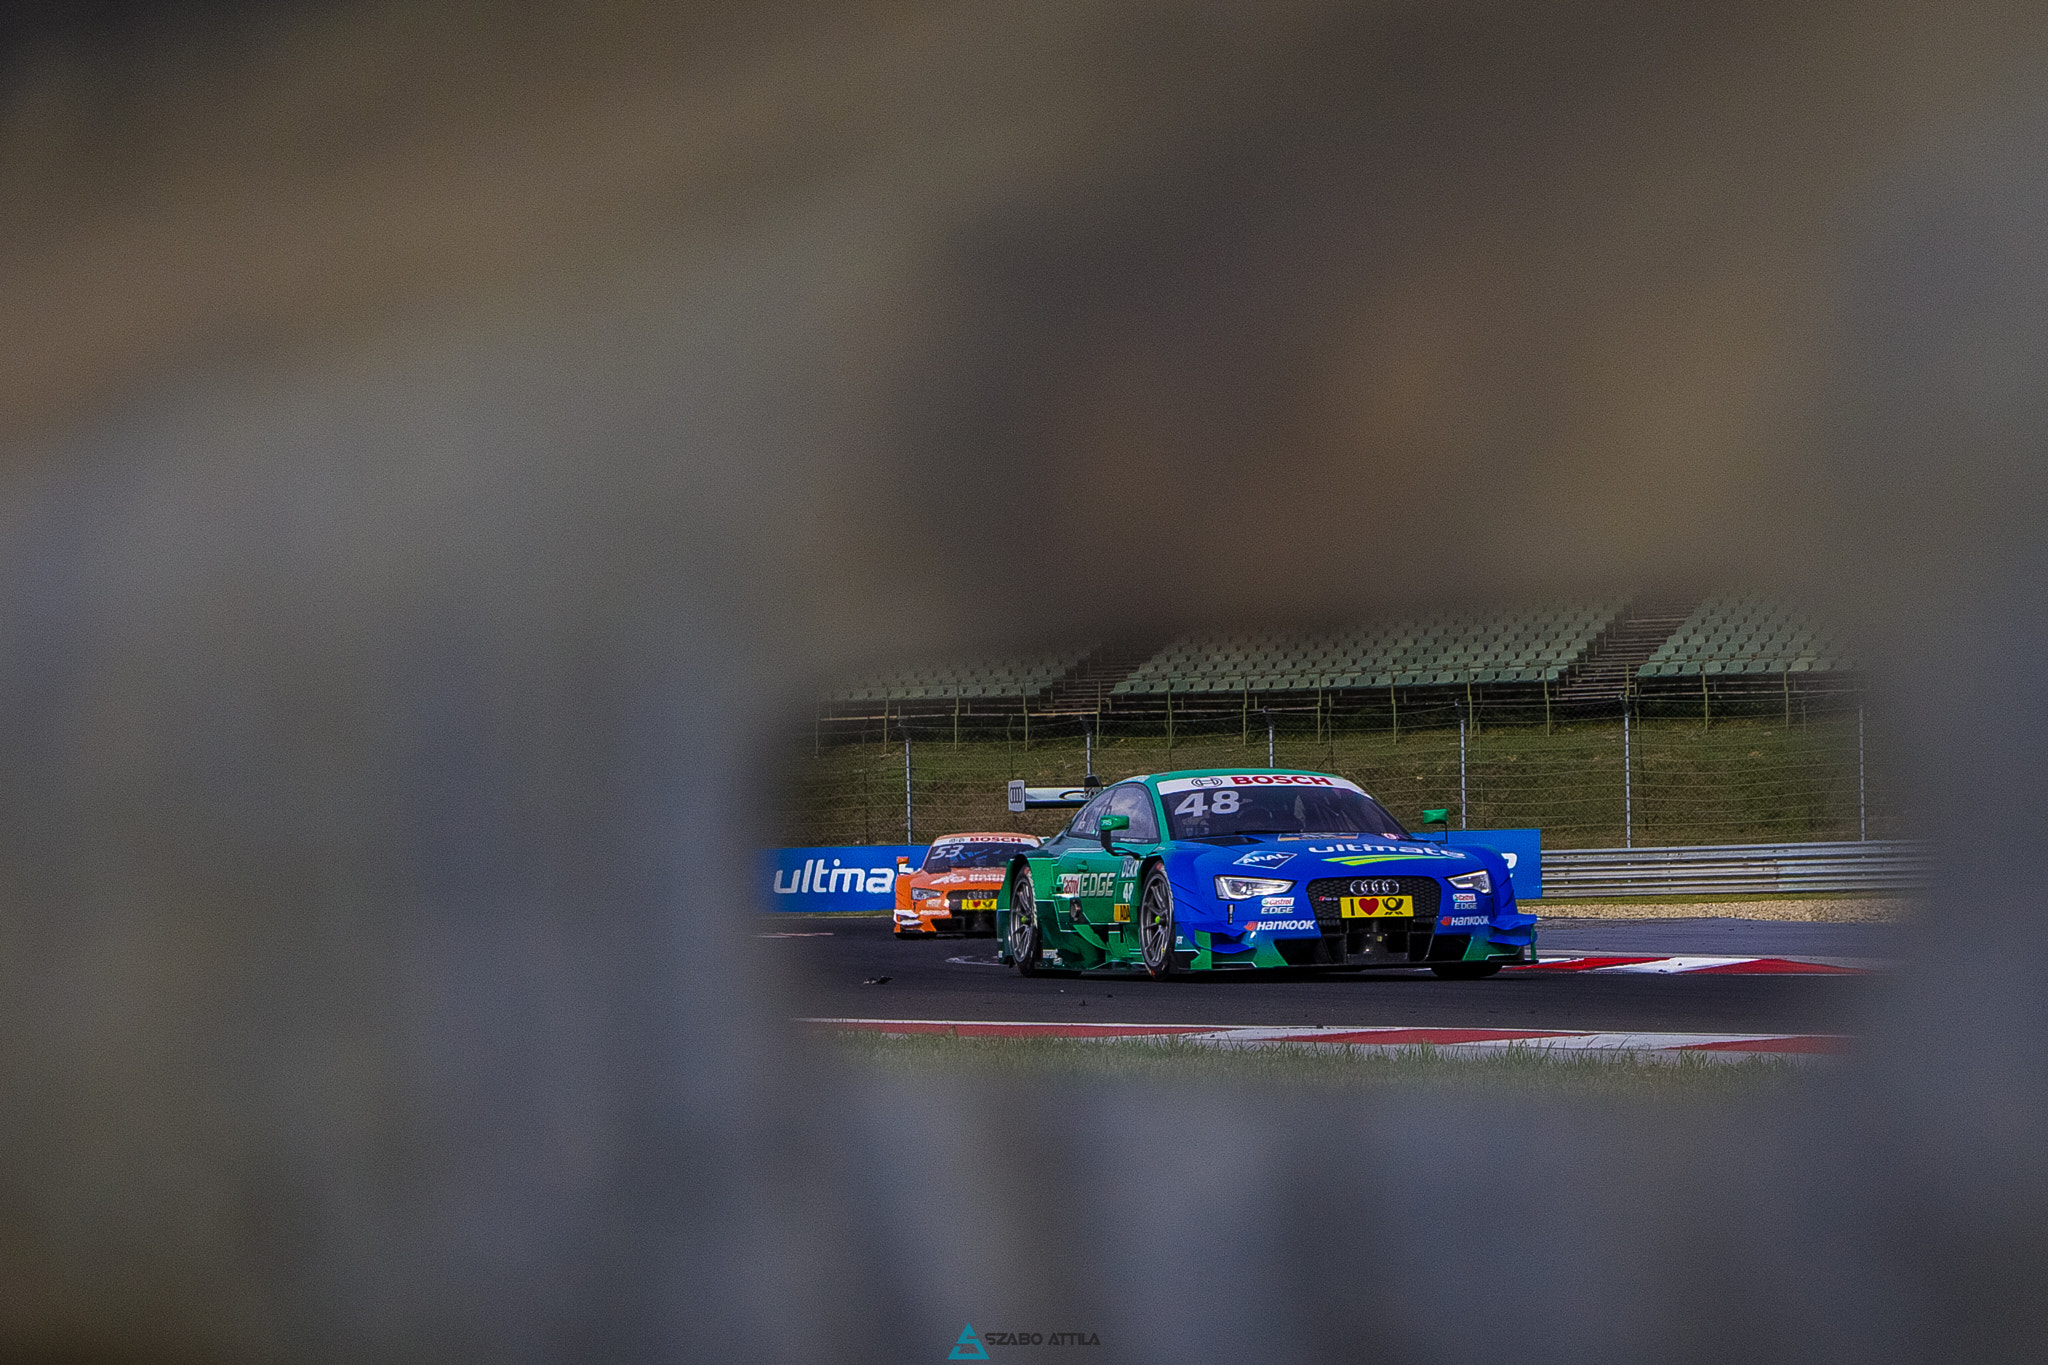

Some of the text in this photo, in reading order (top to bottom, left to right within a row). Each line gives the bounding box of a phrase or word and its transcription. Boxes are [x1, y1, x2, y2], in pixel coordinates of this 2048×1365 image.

[1231, 775, 1333, 786] BOSCH
[1174, 790, 1240, 817] 48
[930, 844, 964, 860] 53
[1242, 852, 1290, 865] ARAL
[1308, 843, 1466, 859] ultimate
[773, 858, 921, 893] ultima
[1080, 872, 1116, 897] EDGE
[1260, 906, 1295, 914] EDGE
